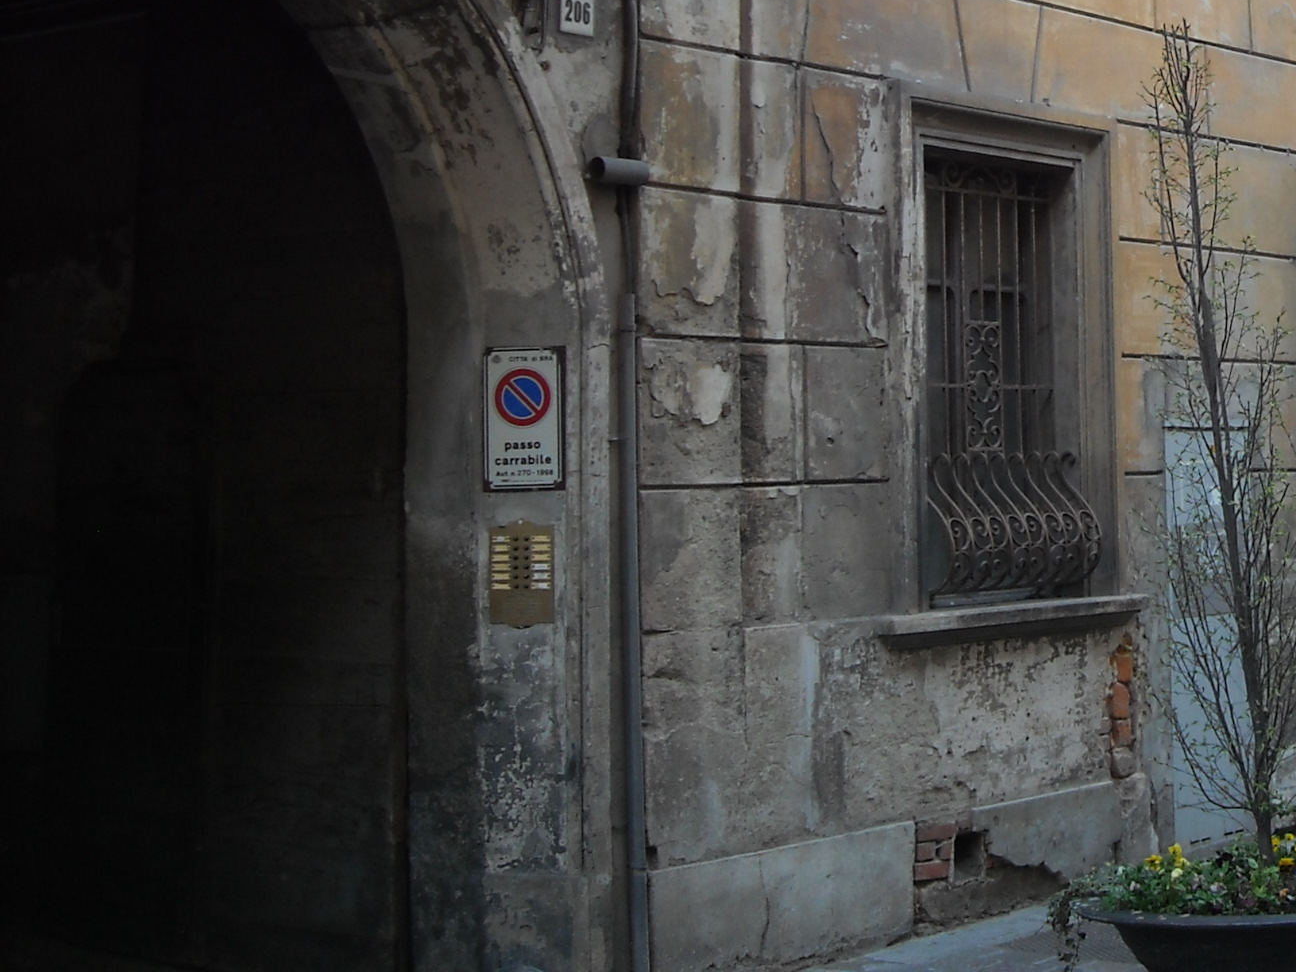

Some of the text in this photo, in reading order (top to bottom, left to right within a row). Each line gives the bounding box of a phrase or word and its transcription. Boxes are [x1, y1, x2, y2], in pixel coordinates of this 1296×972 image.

[565, 0, 591, 24] 206
[504, 441, 541, 453] passo
[494, 454, 552, 466] carrabile
